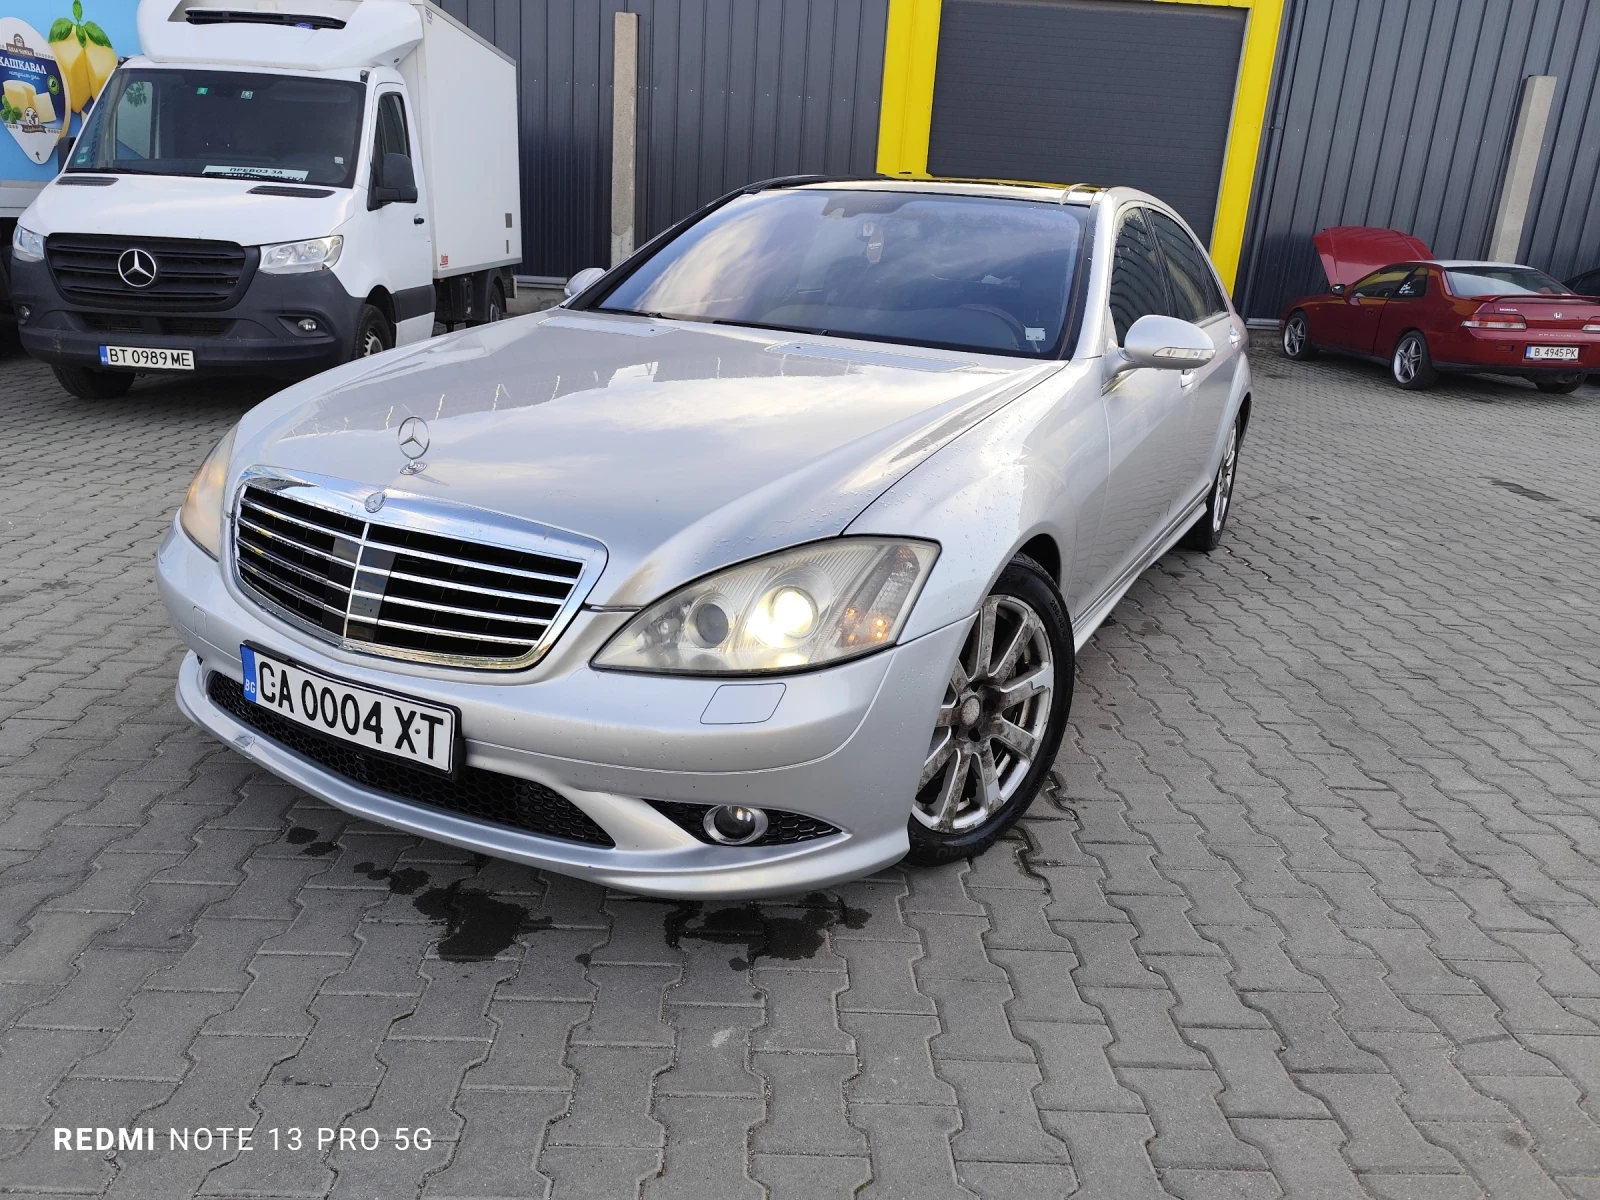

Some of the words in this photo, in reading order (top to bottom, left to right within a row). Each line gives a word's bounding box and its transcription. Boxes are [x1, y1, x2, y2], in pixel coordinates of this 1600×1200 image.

[0, 56, 47, 74] КАШКАВАЛ
[109, 348, 128, 363] BT
[131, 350, 168, 365] 0989
[170, 352, 191, 366] ME
[1544, 348, 1564, 357] 4945
[1565, 348, 1577, 358] PK
[244, 678, 256, 694] BG
[259, 661, 295, 714] CA
[301, 680, 383, 744] 0004
[394, 705, 444, 760] XT
